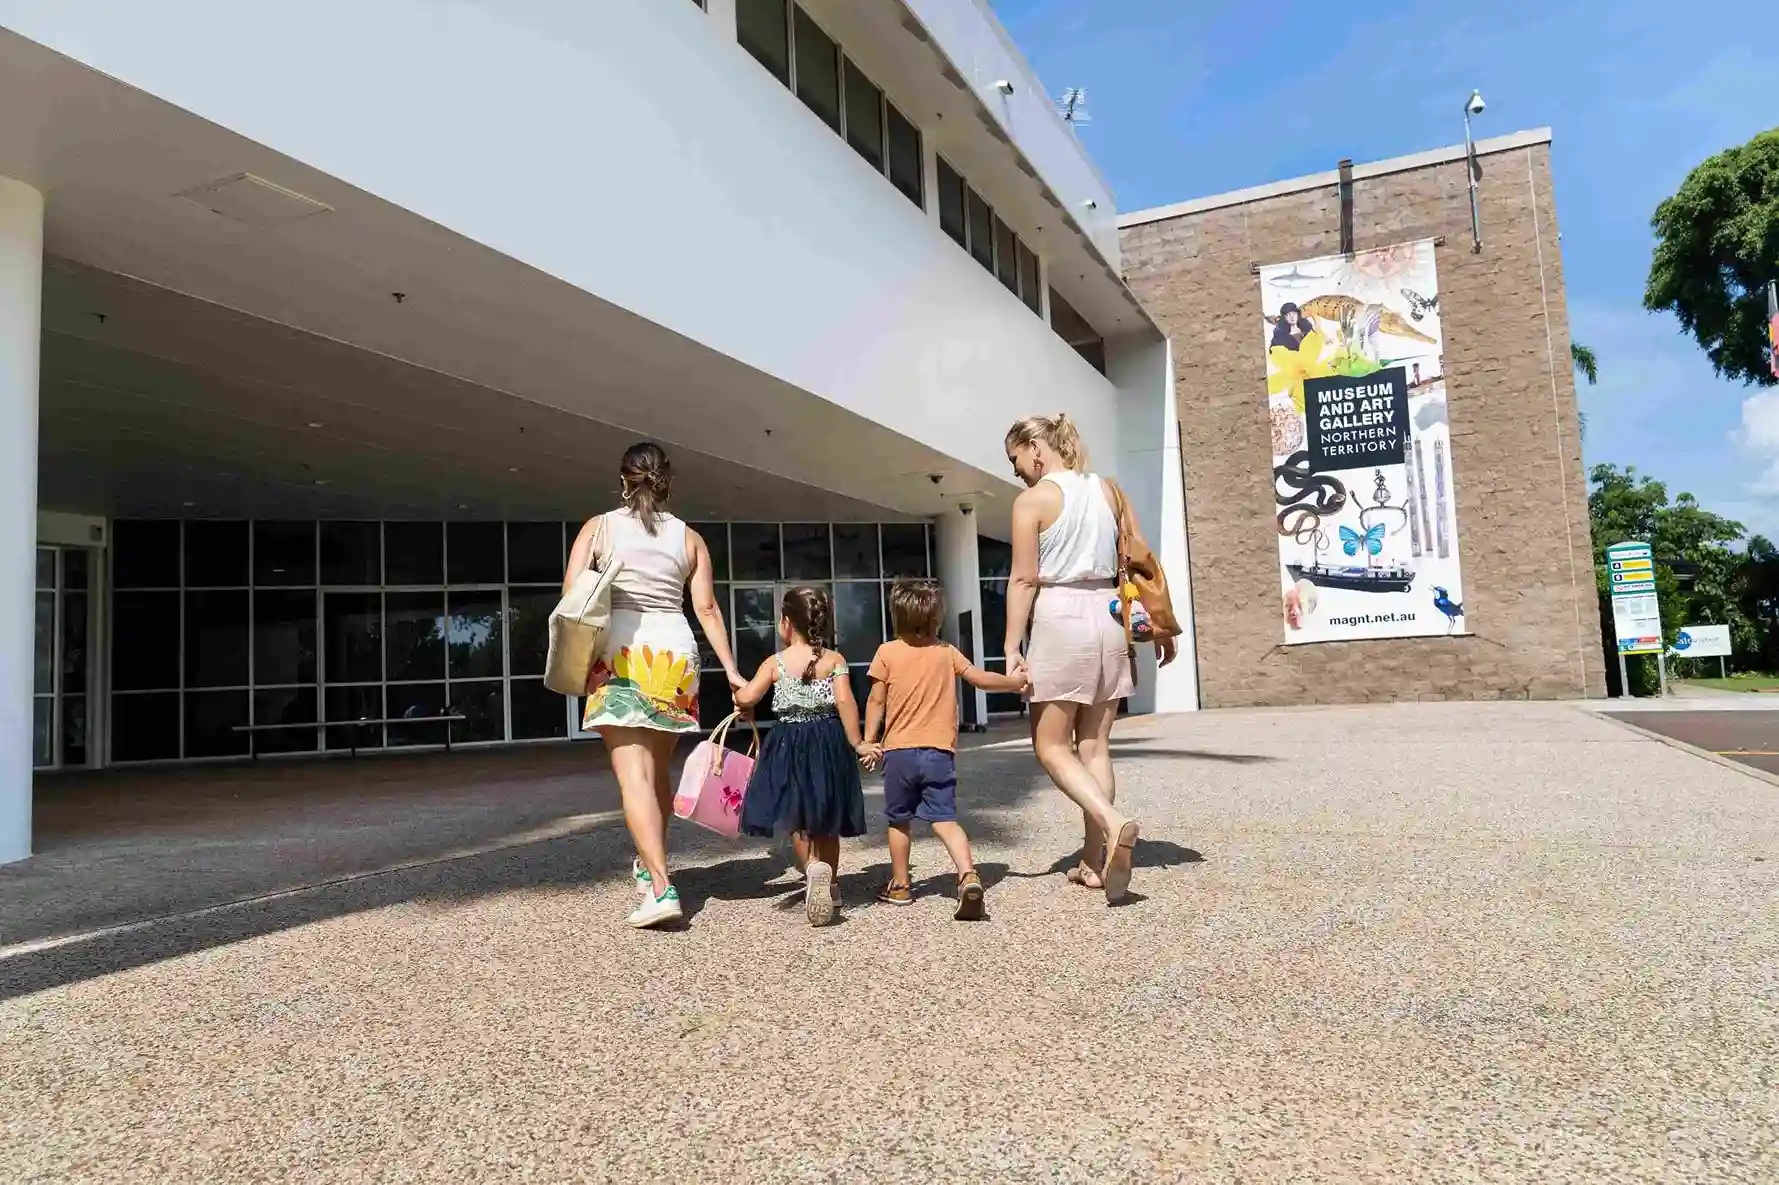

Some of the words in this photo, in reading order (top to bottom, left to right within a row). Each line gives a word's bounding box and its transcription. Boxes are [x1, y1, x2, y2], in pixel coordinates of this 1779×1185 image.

[1318, 382, 1393, 403] MUSEUM
[1319, 403, 1355, 417] AND
[1360, 397, 1394, 412] ART
[1319, 411, 1394, 430] GALLERY
[1321, 427, 1396, 443] NORTHERN
[1322, 440, 1396, 456] TERRITORY
[1330, 613, 1414, 626] magnt.net.au
